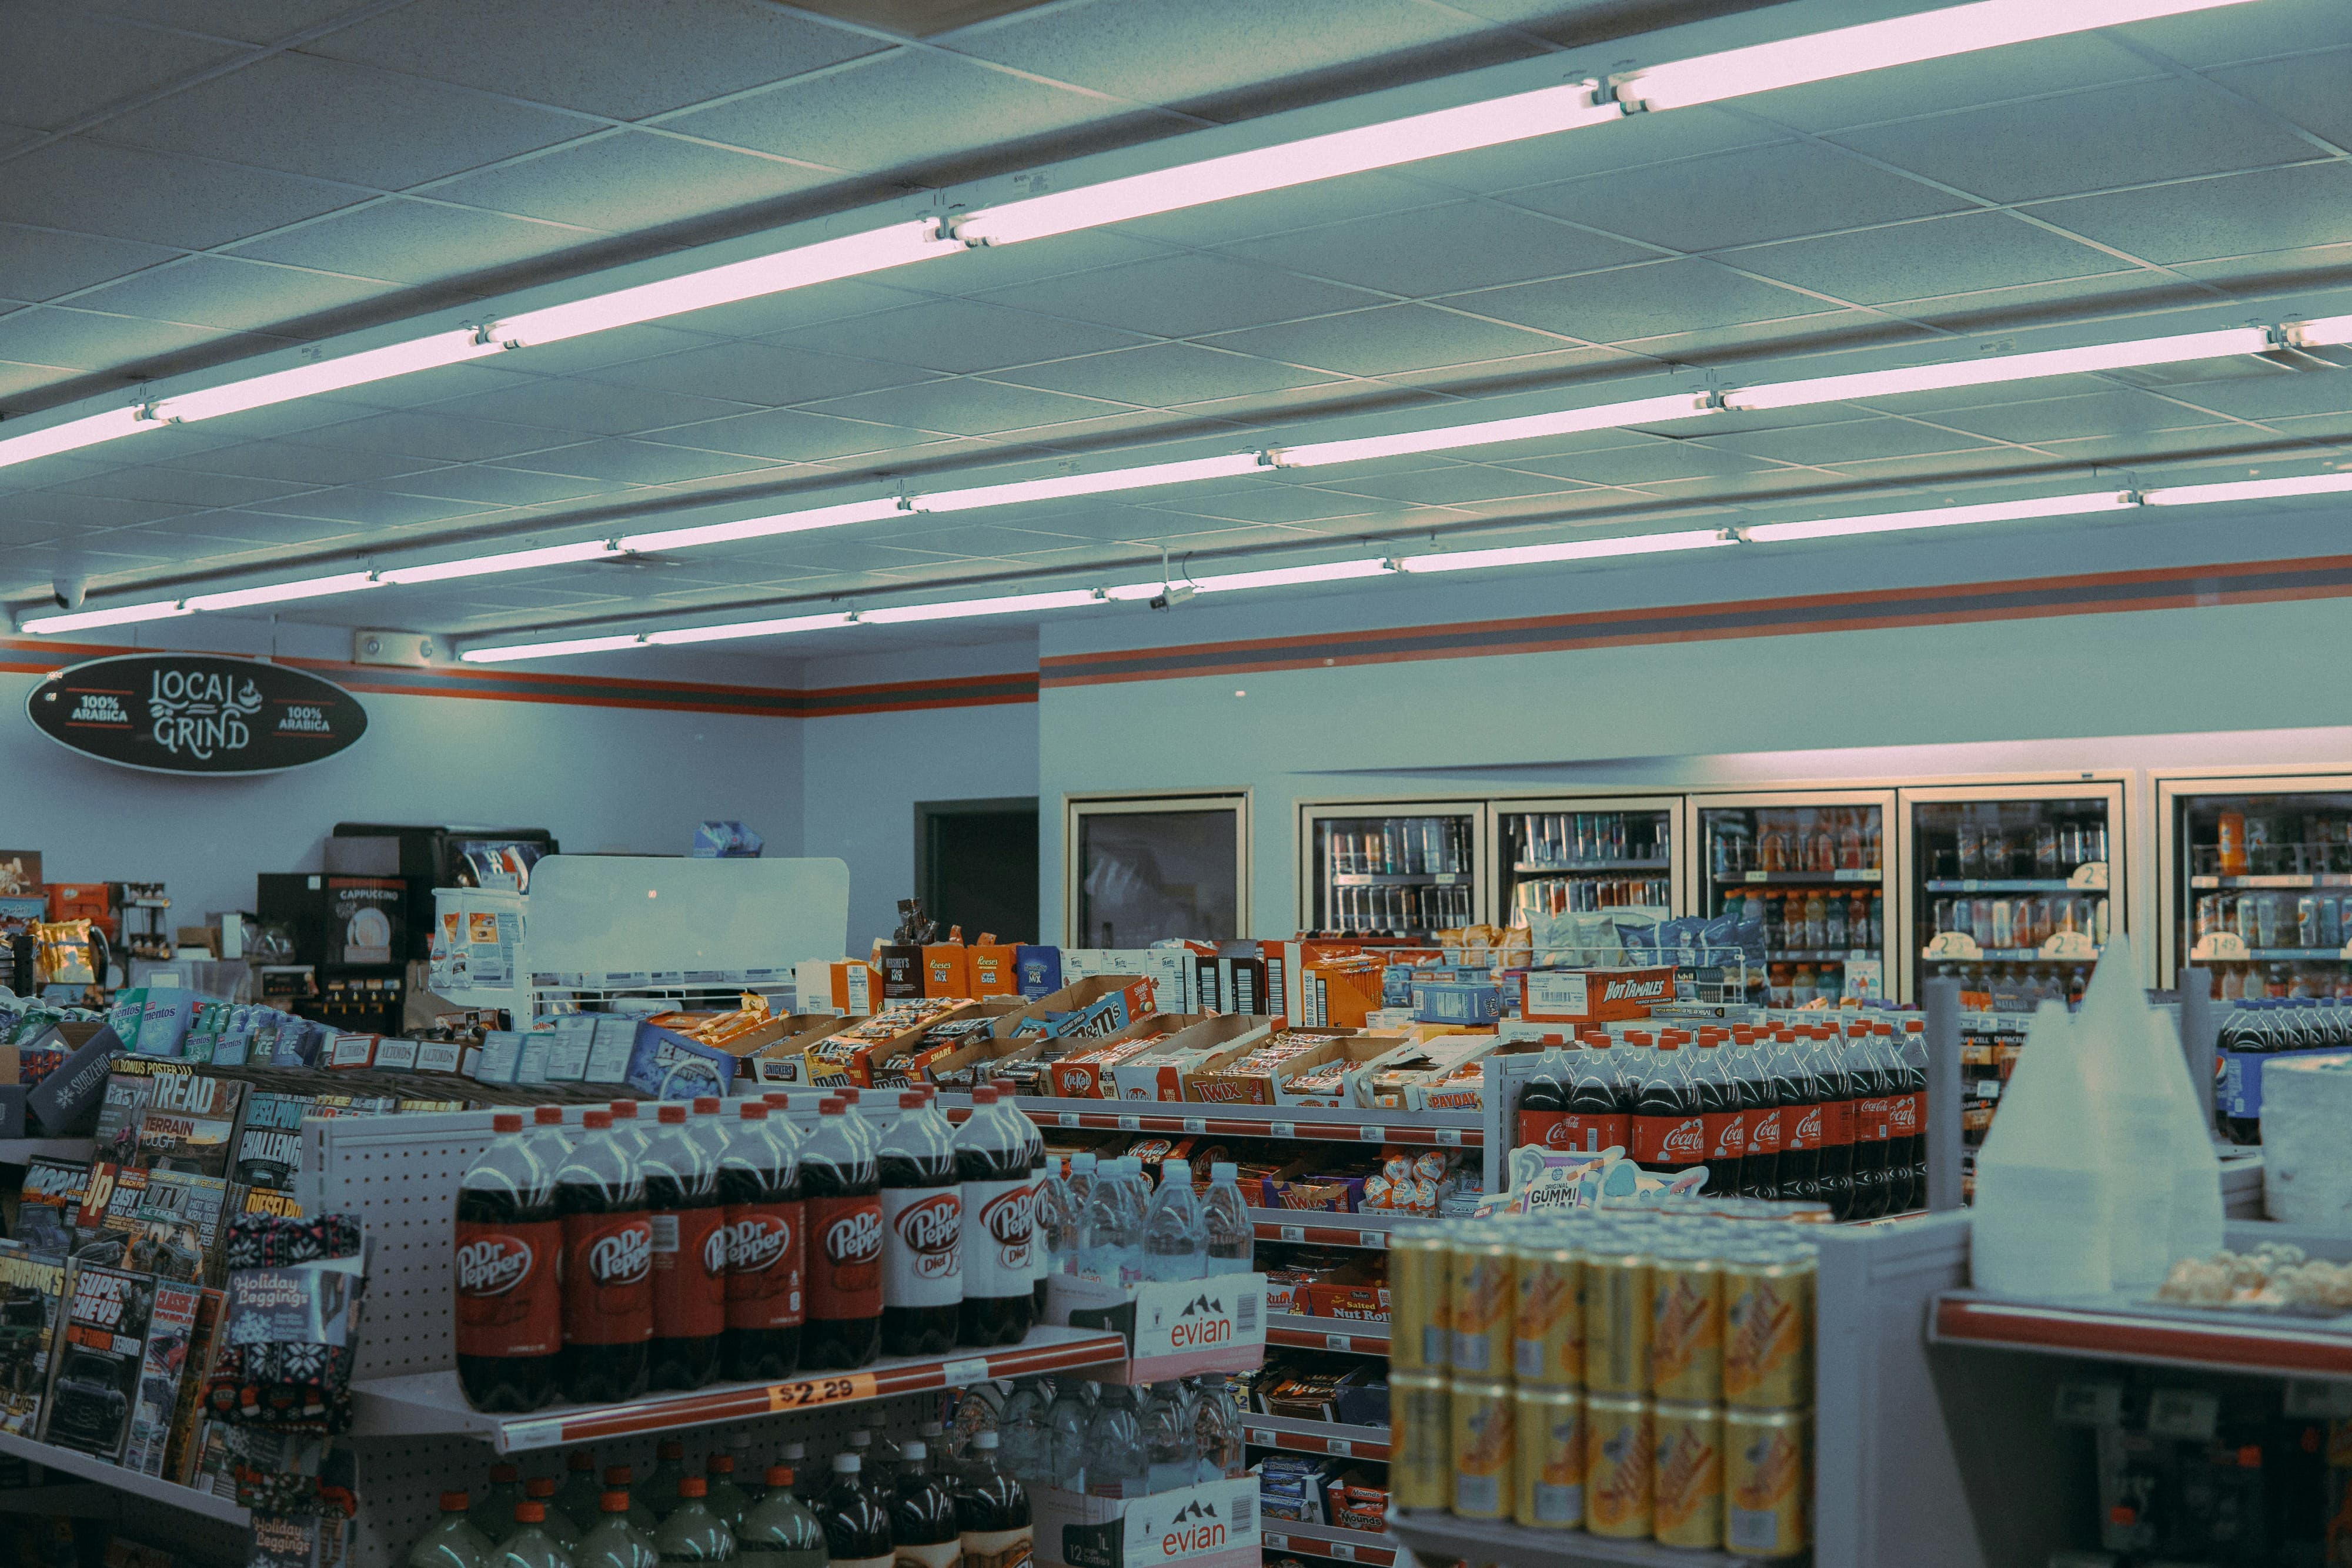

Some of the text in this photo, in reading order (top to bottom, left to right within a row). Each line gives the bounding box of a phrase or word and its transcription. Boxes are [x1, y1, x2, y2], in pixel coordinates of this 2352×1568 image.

[148, 670, 244, 709] LOCAL
[81, 695, 119, 710] 100%
[72, 707, 128, 723] ARABICA
[287, 706, 322, 720] 100%
[278, 718, 330, 733] ARABICA
[153, 708, 249, 759] GRIND
[340, 890, 399, 901] CAPPUCCINO
[886, 958, 910, 968] HERSHEY'S
[930, 959, 951, 969] Reese's
[977, 955, 998, 965] Reese's
[1676, 972, 1694, 981] Advil
[1133, 982, 1149, 996] SHARE
[1138, 992, 1148, 1001] SIZE
[1602, 978, 1665, 1004] HOT TAMALES
[1650, 997, 1672, 1005] CINNAMON
[143, 1007, 176, 1022] mentos
[1067, 1001, 1121, 1038] m&m's
[1307, 1017, 1314, 1026] BB
[1058, 1013, 1085, 1034] HAZELNUT SPREAD
[186, 1036, 211, 1047] mentos
[218, 1039, 242, 1050] mentos
[254, 1041, 273, 1056] ICE
[277, 1041, 298, 1055] ICE
[381, 1045, 412, 1059] ALTOIDS
[422, 1048, 455, 1063] ALTOIDS
[930, 1046, 952, 1064] SHARE
[71, 1053, 111, 1092] SUBZERO
[120, 1059, 177, 1075] BONUS POSTER
[764, 1064, 793, 1076] SNICKERS
[811, 1074, 851, 1088] m&m's
[1063, 1072, 1092, 1089] KitKat
[150, 1072, 215, 1114] TREAD
[1125, 1089, 1151, 1101] KitKat
[1192, 1077, 1242, 1104] Twix
[1431, 1091, 1477, 1110] PAYDAY
[145, 1117, 195, 1136] TERRAIN
[142, 1130, 177, 1149] TOUGH
[256, 1161, 272, 1171] EVENT
[82, 1161, 113, 1216] Jp
[118, 1178, 136, 1187] BEACH
[1545, 1182, 1569, 1191] ORIGINAL
[111, 1187, 139, 1207] EASY
[142, 1182, 191, 1211] UTV
[1531, 1187, 1578, 1204] GUMMI
[108, 1204, 124, 1215] YOU
[139, 1207, 180, 1219] ACTION
[189, 1199, 218, 1212] HOT NEW
[1474, 1208, 1491, 1218] NEW
[186, 1209, 219, 1224] KRX 1000
[934, 1203, 956, 1226] Dr
[199, 1223, 216, 1235] FIRST
[856, 1212, 877, 1235] Dr
[737, 1221, 767, 1242] Dr
[199, 1235, 215, 1246] TEST
[621, 1229, 645, 1253] Dr
[723, 1226, 784, 1265] Pepper
[475, 1241, 505, 1263] Dr
[1007, 1245, 1027, 1265] Diet
[457, 1245, 526, 1289] Pepper
[924, 1253, 947, 1273] Diet
[77, 1271, 133, 1302] SUPER
[233, 1272, 299, 1293] Holiday
[236, 1289, 309, 1308] Leggings
[1295, 1302, 1301, 1310] 2
[1347, 1301, 1376, 1310] Salted
[70, 1293, 125, 1325] CHEVY
[1332, 1308, 1392, 1323] Nut Roll
[1171, 1317, 1231, 1347] evian
[779, 1378, 854, 1405] $2.29
[1239, 1395, 1248, 1406] 2
[1351, 1489, 1381, 1499] Mounds
[1340, 1512, 1382, 1526] Mounds
[252, 1516, 303, 1540] Holiday
[256, 1532, 311, 1556] Leggings
[1098, 1533, 1110, 1551] 1L
[1162, 1523, 1226, 1556] evian
[1069, 1544, 1082, 1562] 12
[1084, 1553, 1110, 1567] bottles
